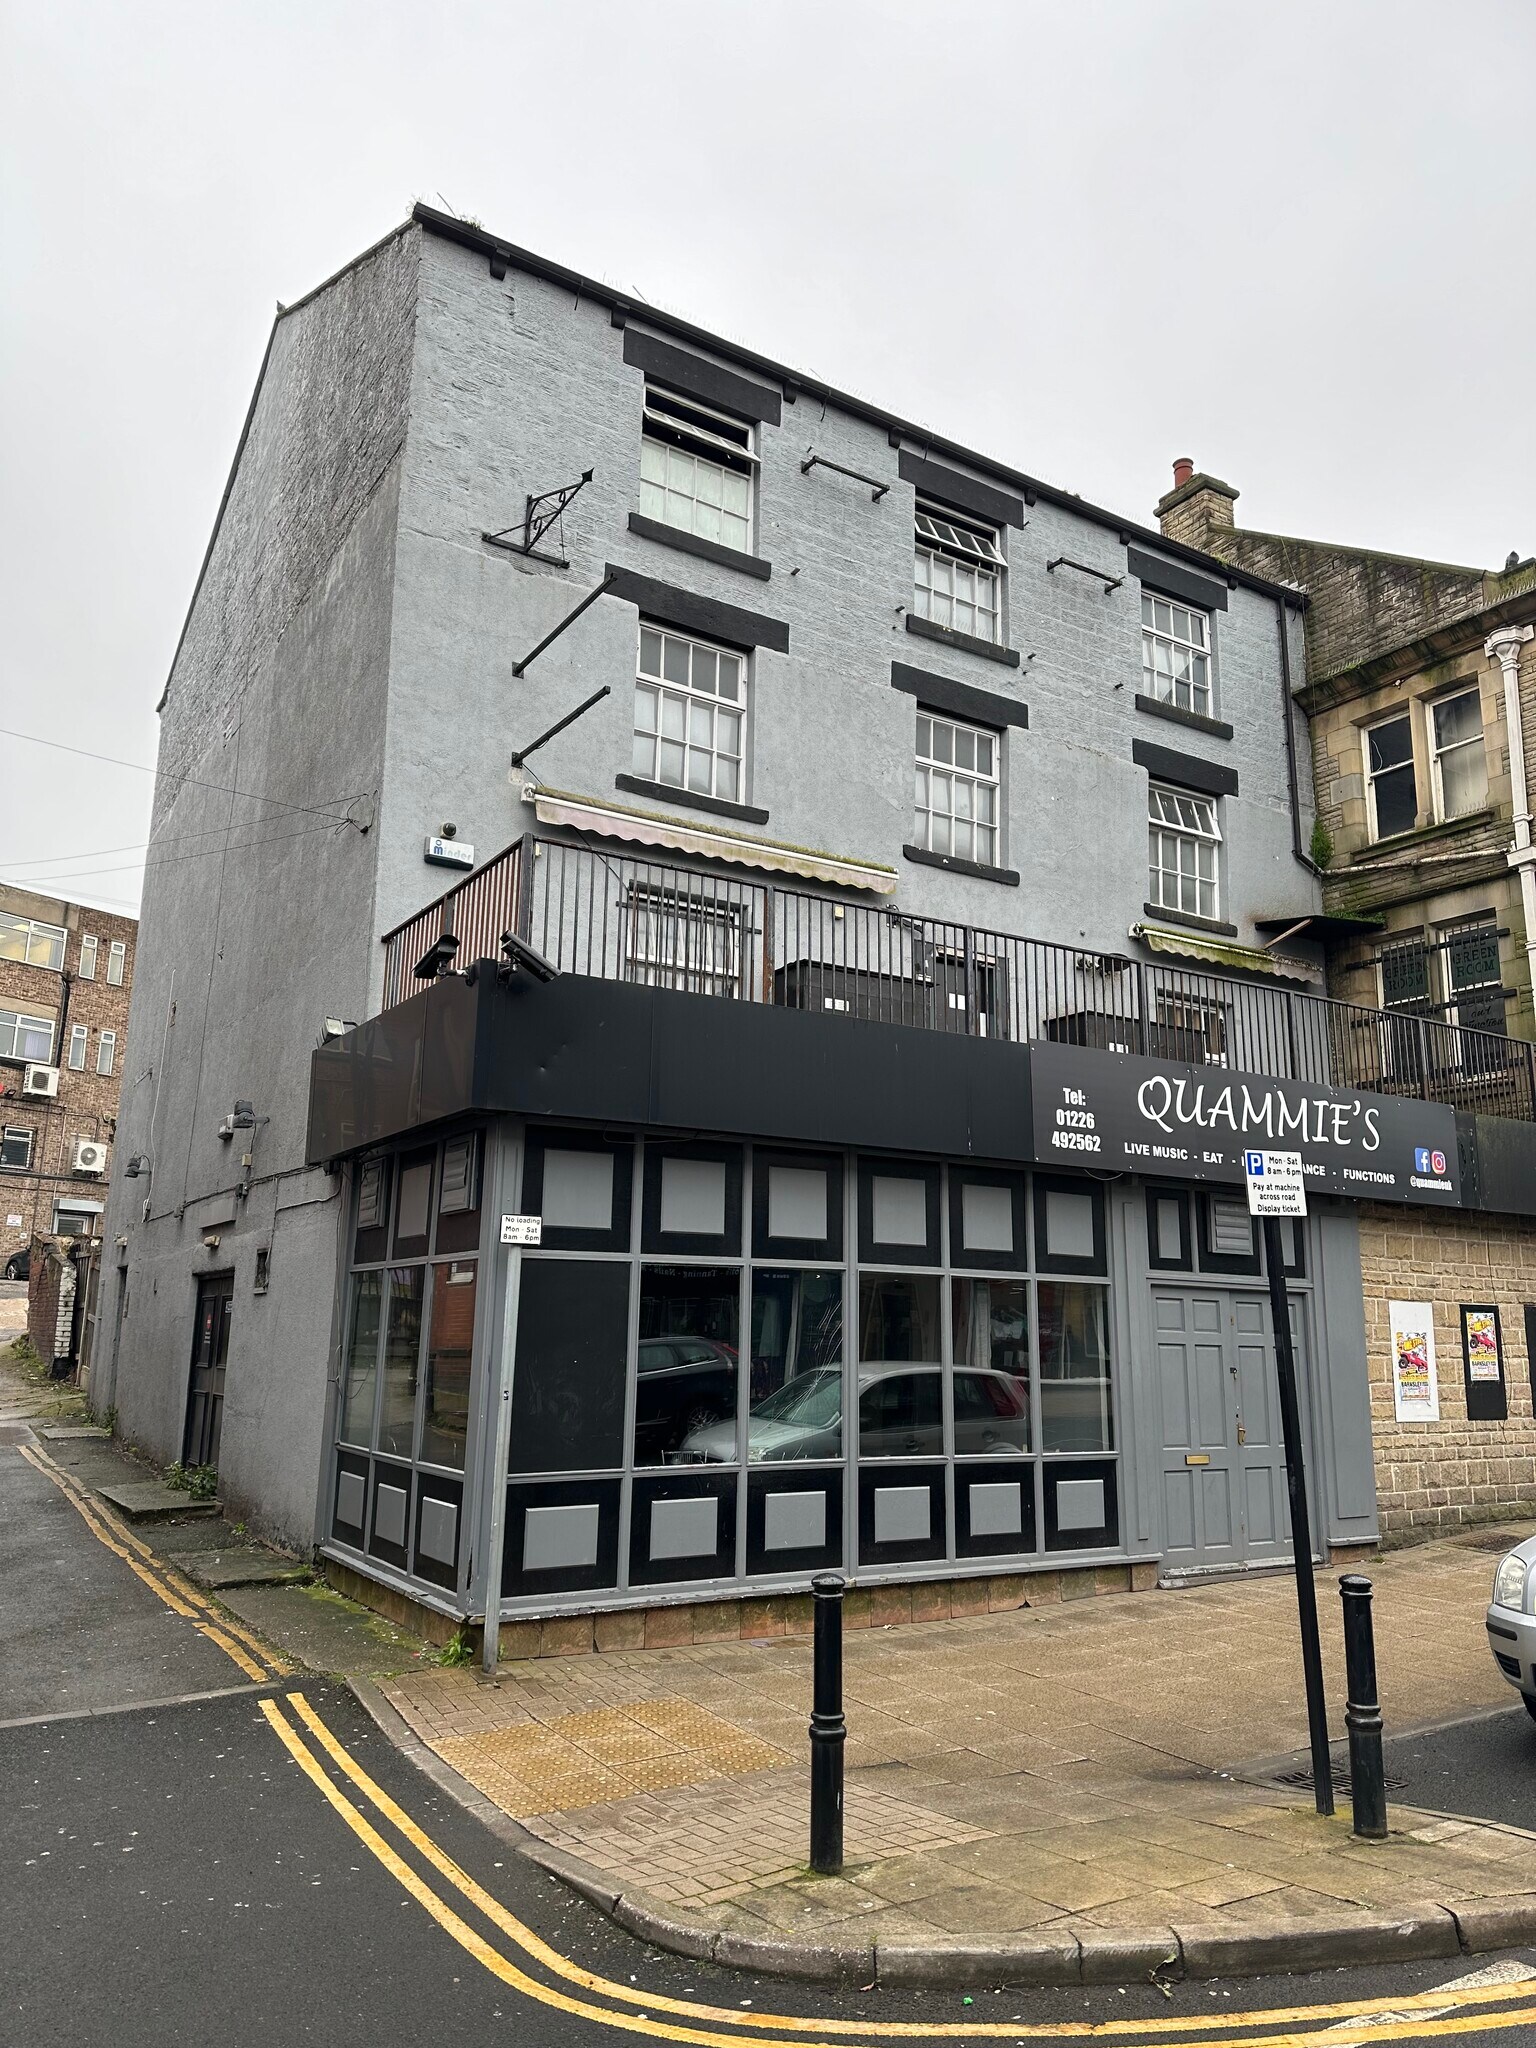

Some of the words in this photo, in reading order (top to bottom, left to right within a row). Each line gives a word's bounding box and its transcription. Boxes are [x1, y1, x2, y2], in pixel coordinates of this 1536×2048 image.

[1452, 946, 1496, 964] GREEN
[1456, 960, 1495, 978] ROOM
[1062, 1088, 1086, 1106] Tel:
[1056, 1108, 1095, 1129] 01226
[1137, 1075, 1380, 1151] QUAMMIE'S
[1052, 1130, 1101, 1152] 492562
[1124, 1142, 1150, 1156] LIVE
[1152, 1146, 1188, 1160] MUSIC
[1203, 1152, 1223, 1164] EAT
[1343, 1168, 1396, 1184] FUNCTIONS
[1253, 1182, 1264, 1191] Pay
[1258, 1204, 1280, 1213] Display
